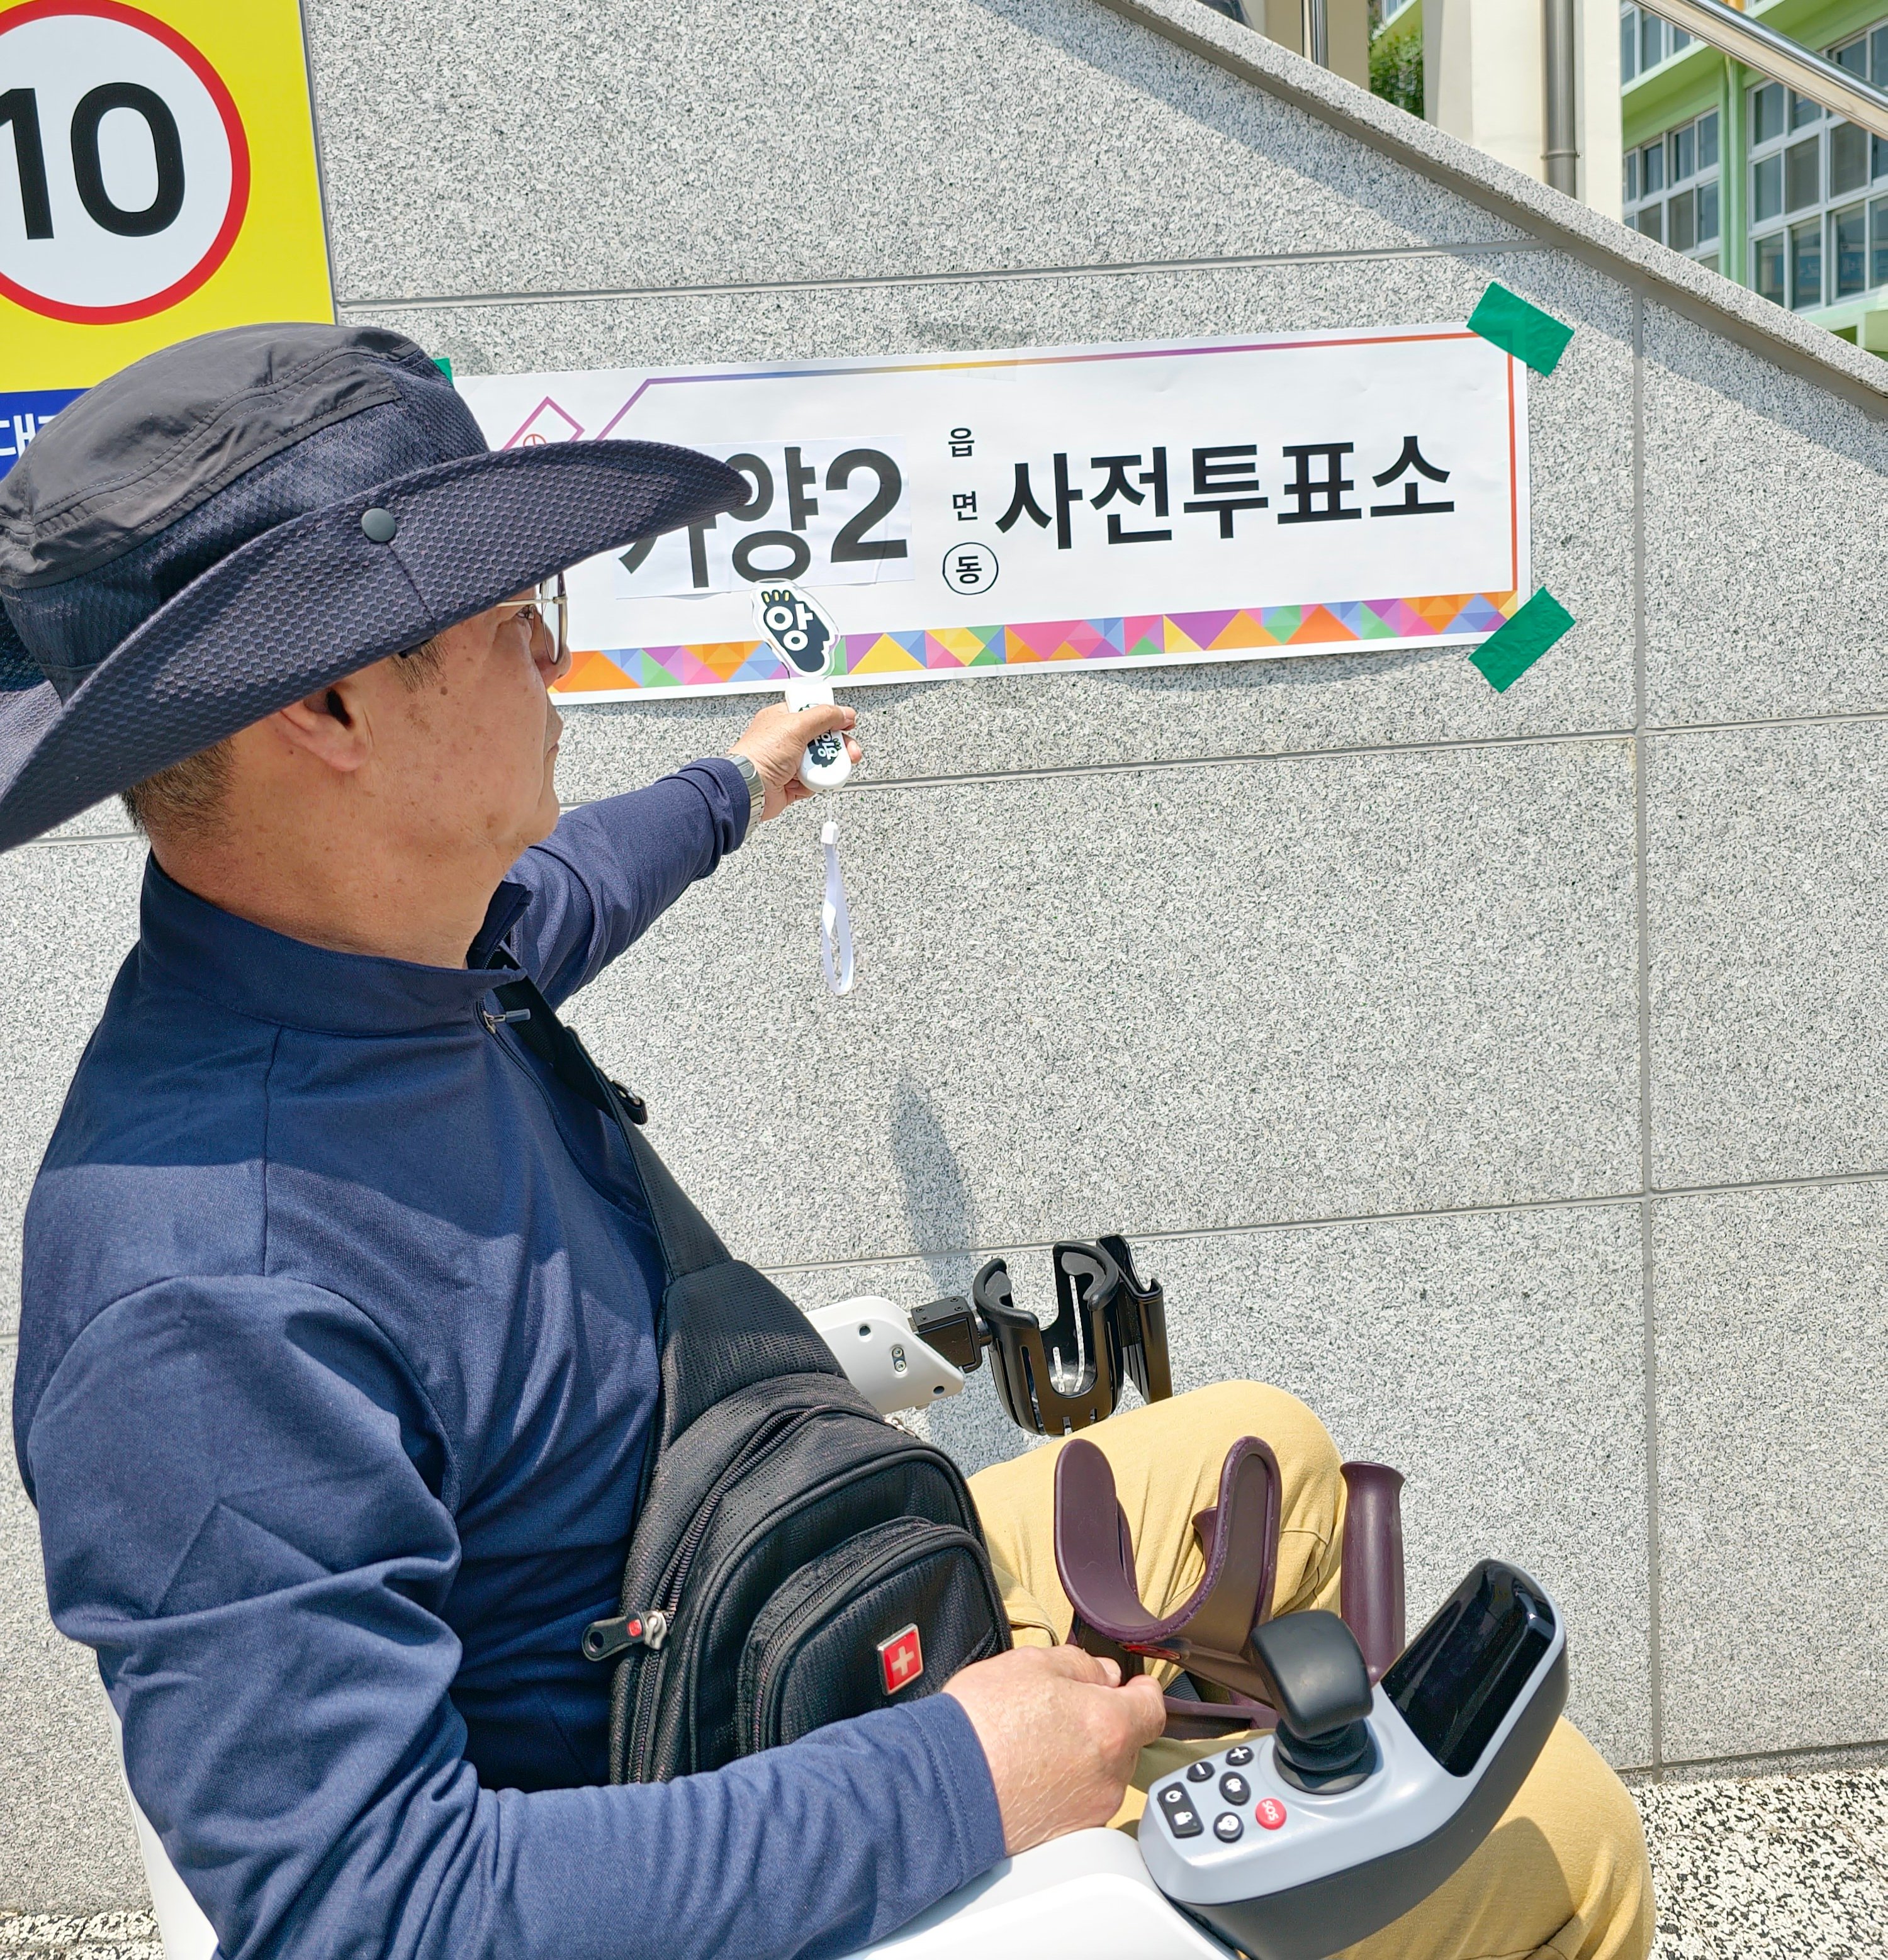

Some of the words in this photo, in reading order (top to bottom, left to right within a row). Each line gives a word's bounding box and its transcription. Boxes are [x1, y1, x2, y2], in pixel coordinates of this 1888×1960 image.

[0, 82, 185, 239] 10
[948, 427, 975, 457] 읍
[952, 491, 978, 521] 면
[996, 435, 1454, 549] 사전투표소
[955, 556, 982, 584] 동
[766, 603, 814, 651] 앙
[1261, 1800, 1279, 1822] SOS
